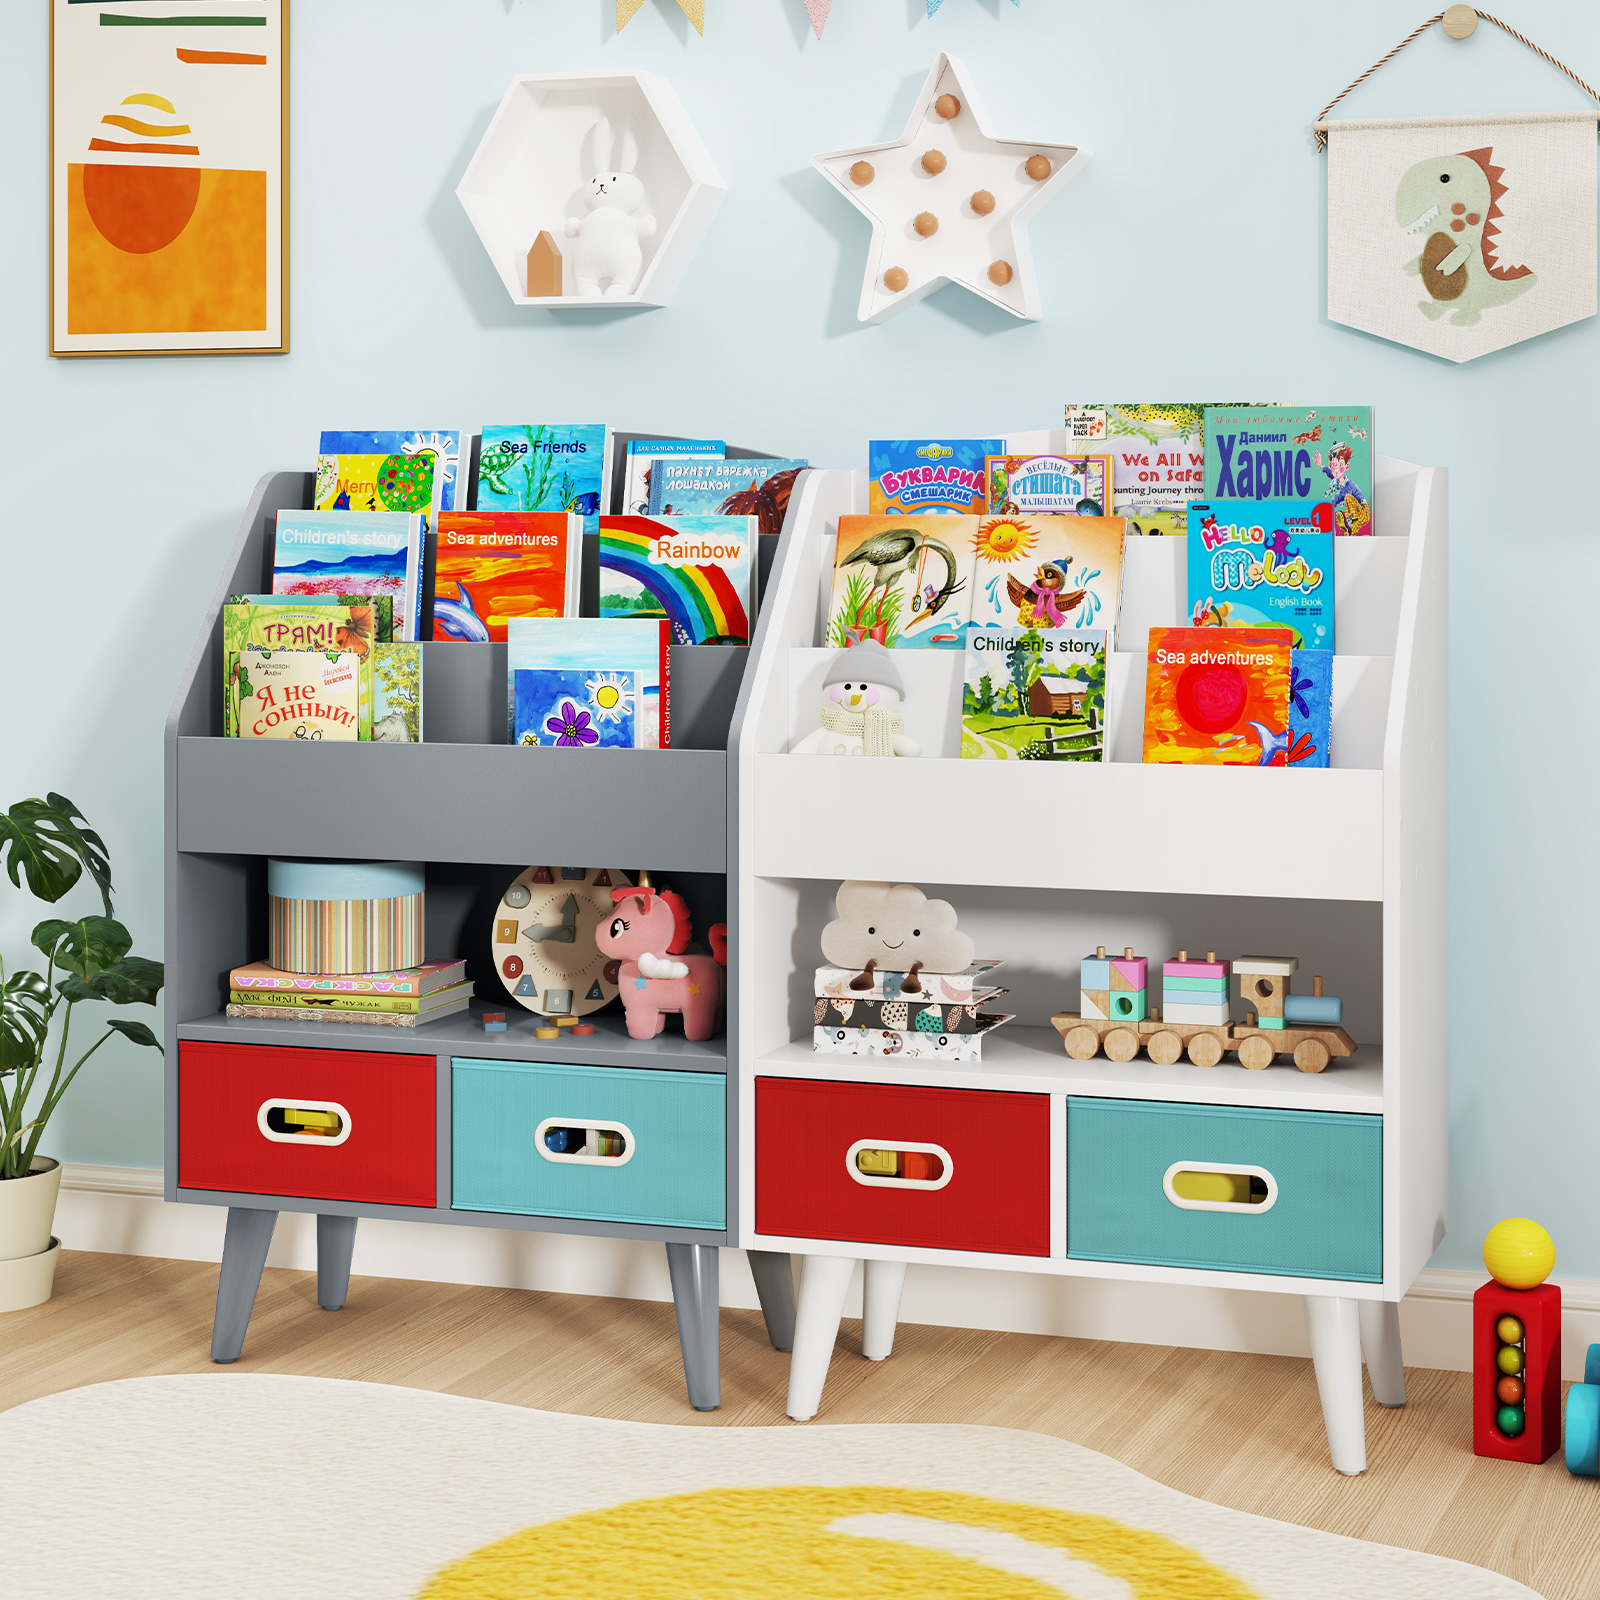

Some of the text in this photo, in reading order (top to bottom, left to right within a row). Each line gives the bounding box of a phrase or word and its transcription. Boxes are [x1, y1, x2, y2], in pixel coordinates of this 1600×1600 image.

[1215, 416, 1238, 424] Мои
[1245, 415, 1300, 423] любимые
[1239, 432, 1287, 445] Даниил
[501, 440, 586, 453] Sea Friends
[1122, 453, 1204, 466] We All W
[1026, 460, 1068, 474] ВЕСЁЛЫЕ
[1215, 434, 1311, 500] Хармс
[1138, 469, 1204, 482] on Safa
[336, 479, 414, 497] Merry City
[902, 487, 971, 501] СМЕШАРИК
[1113, 486, 1145, 496] ounting
[1148, 486, 1182, 496] Journey
[1021, 498, 1074, 506] МАЛЫШАТАМ
[1313, 512, 1320, 525] 1
[282, 529, 402, 549] Children's story
[447, 531, 558, 546] Sea adventures
[1201, 525, 1264, 550] HELLO
[657, 541, 740, 558] Rainbow
[1270, 596, 1323, 608] English Book
[263, 622, 333, 644] ТРЯМ!
[973, 636, 1100, 656] Children's story
[1156, 648, 1273, 665] Sea adventures
[256, 684, 315, 712] Я не
[252, 702, 356, 736] сонный!
[512, 891, 521, 899] 10
[504, 928, 510, 936] 9
[510, 963, 516, 972] 8
[233, 977, 412, 992] РАСКРАСКА
[592, 989, 598, 997] 5
